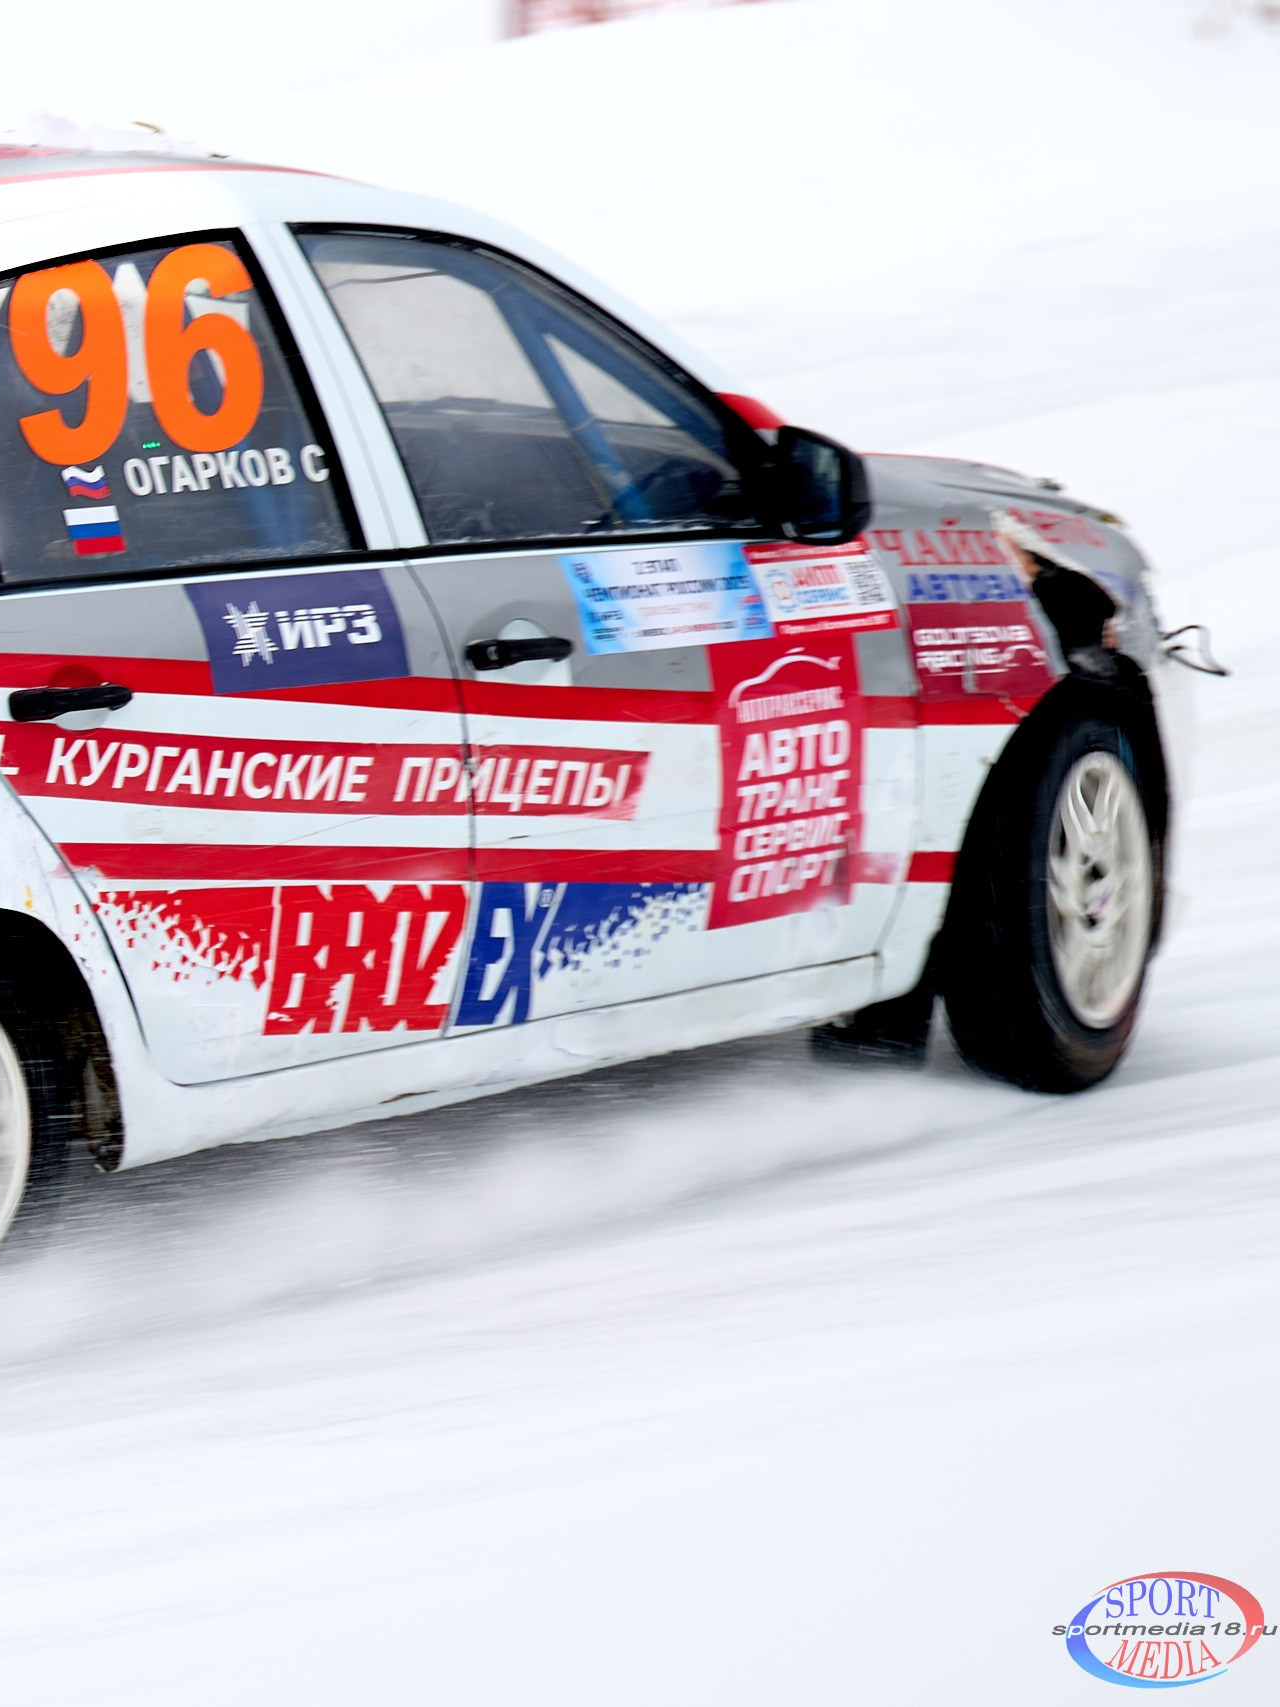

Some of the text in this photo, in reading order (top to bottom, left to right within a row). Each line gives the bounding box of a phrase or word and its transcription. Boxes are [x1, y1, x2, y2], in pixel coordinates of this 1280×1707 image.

[9, 243, 264, 465] 96
[123, 444, 330, 496] ОГАРКОВ С
[274, 604, 382, 650] ИРЗ
[45, 737, 632, 812] КУРГАНСКИЕ ПРИЦЕПЫ
[737, 719, 851, 781] АВТО
[737, 769, 851, 823] ТРАНС
[733, 811, 850, 861] СЕРВИС
[728, 849, 848, 903] СПОРТ
